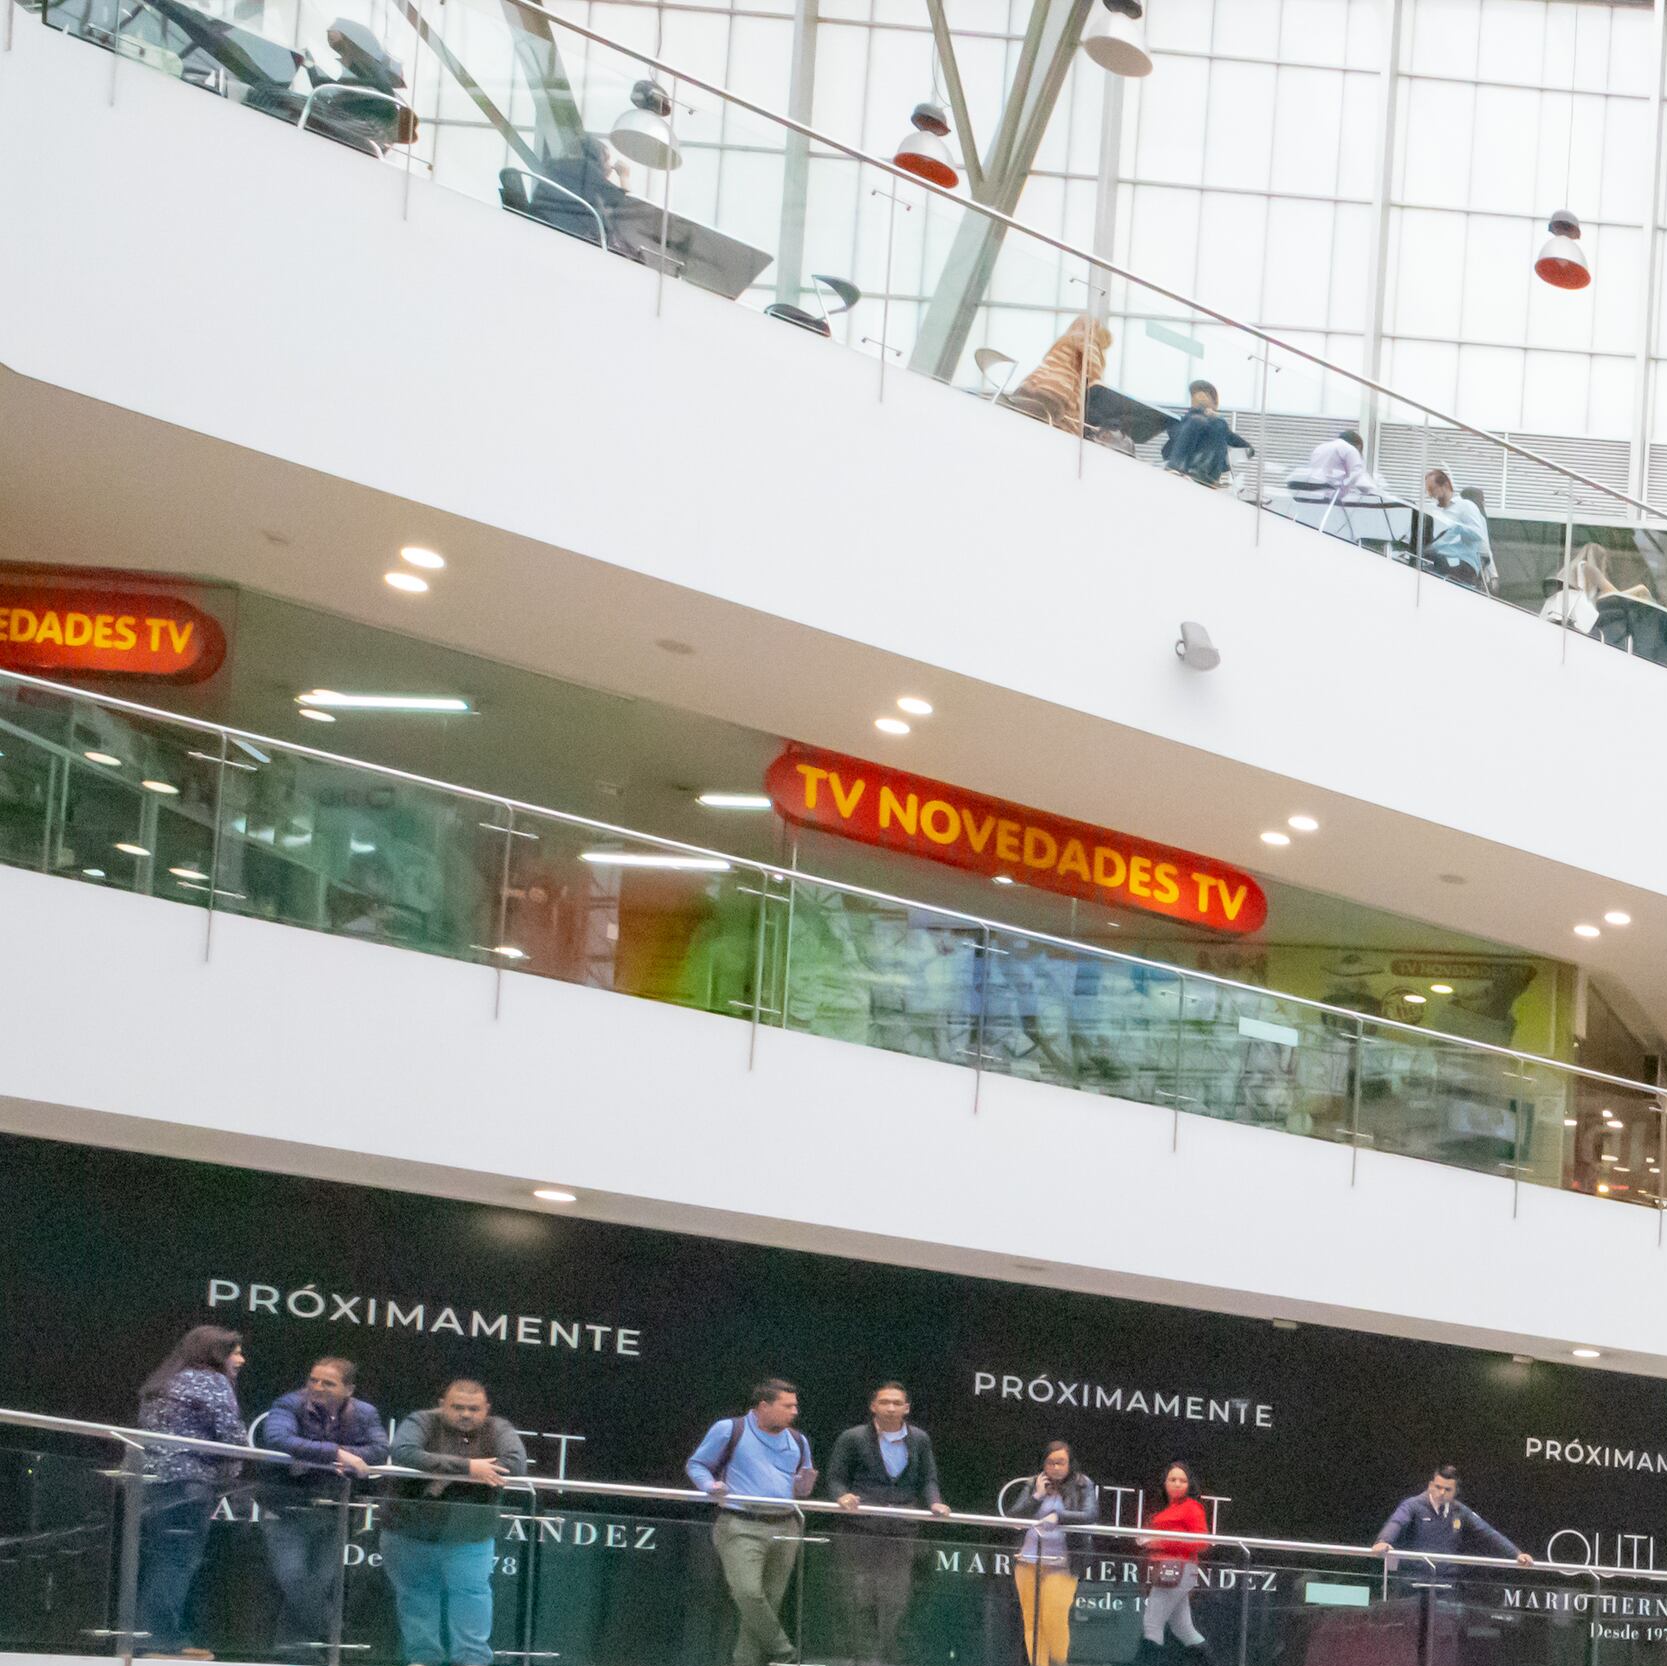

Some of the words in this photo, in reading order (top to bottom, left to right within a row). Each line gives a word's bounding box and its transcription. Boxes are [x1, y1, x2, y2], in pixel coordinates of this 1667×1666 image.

[145, 617, 194, 653] TV
[796, 763, 865, 819] TV
[879, 786, 1180, 904] NOVEDADES
[1192, 872, 1248, 922] TV
[207, 1279, 642, 1357] PRÓXIMAMENTE
[974, 1371, 1273, 1428] PRÓXIMAMENTE
[1075, 1591, 1123, 1612] esde
[1503, 1588, 1588, 1611] MARIO
[1590, 1622, 1640, 1641] Desde
